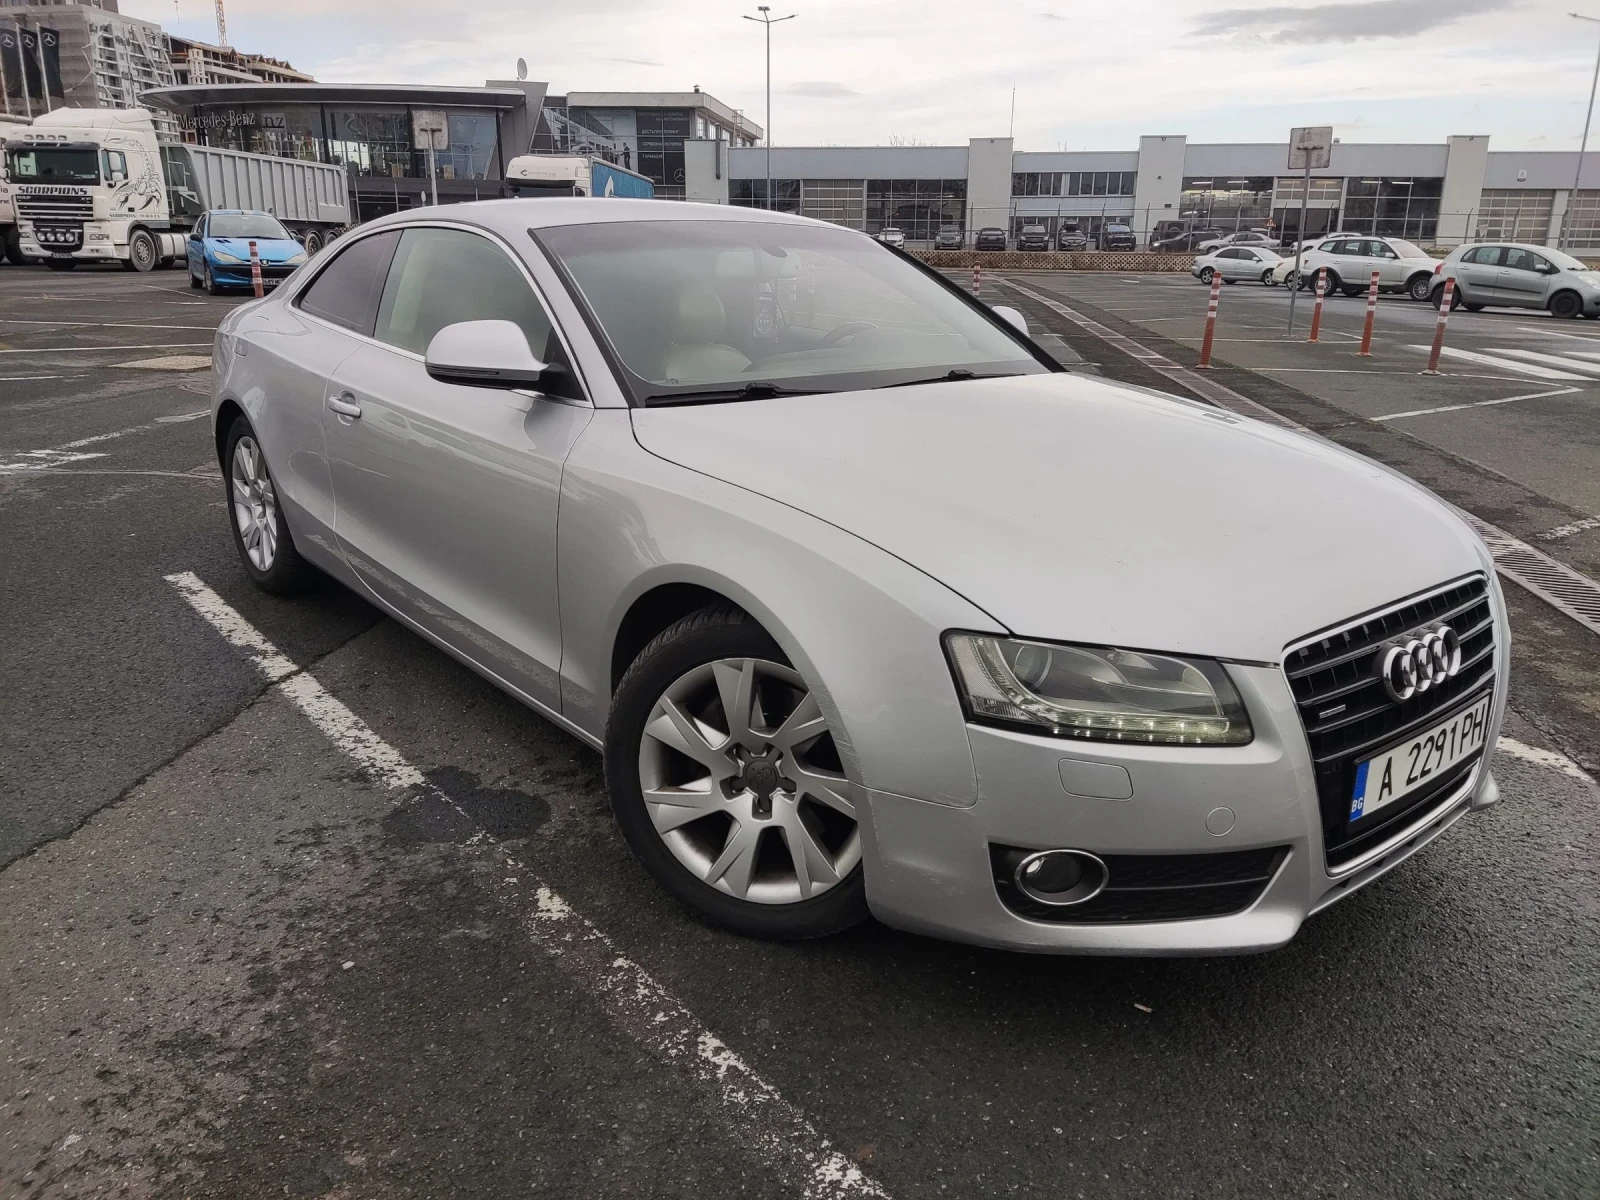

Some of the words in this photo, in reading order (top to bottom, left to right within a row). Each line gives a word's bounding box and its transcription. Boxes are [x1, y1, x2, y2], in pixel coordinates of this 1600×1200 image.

[179, 110, 255, 129] Mercedes-Benz
[18, 185, 88, 195] SCORPIONS
[1378, 756, 1393, 802] A
[1351, 797, 1364, 813] BG
